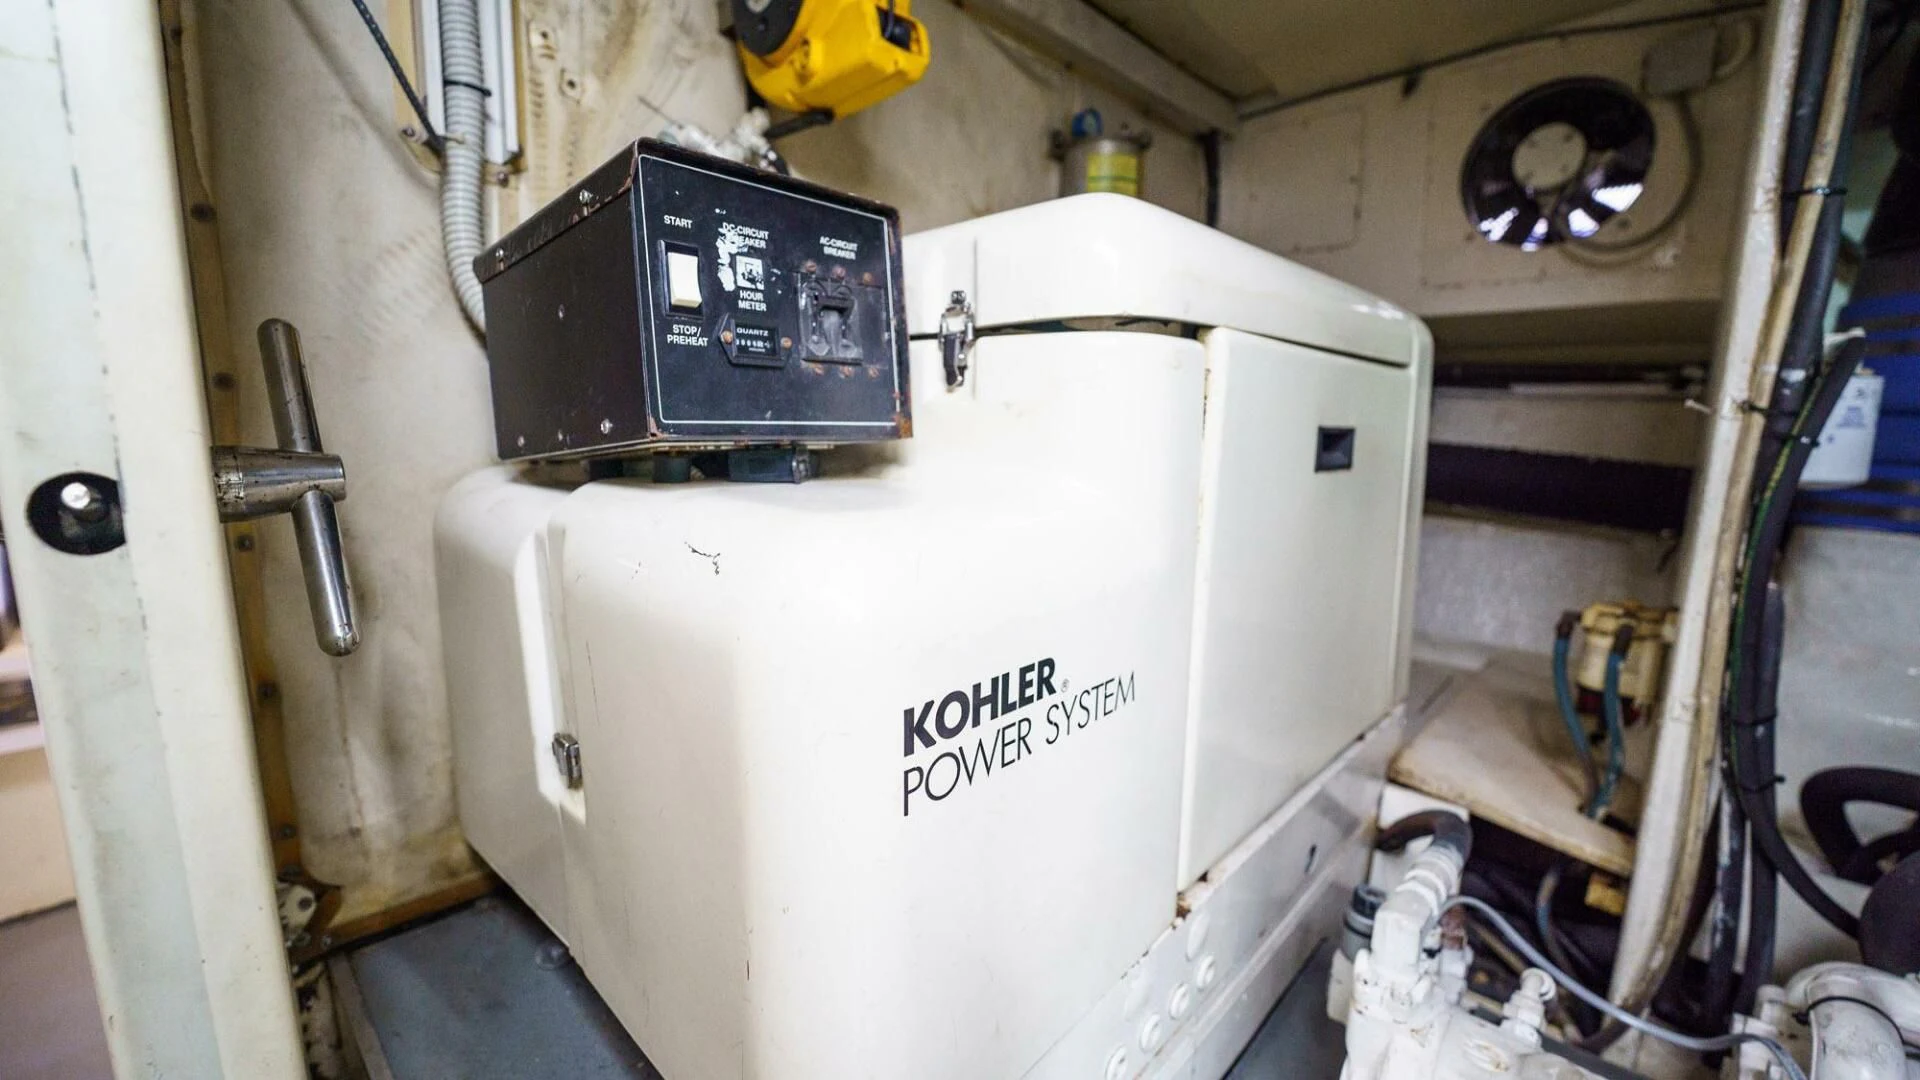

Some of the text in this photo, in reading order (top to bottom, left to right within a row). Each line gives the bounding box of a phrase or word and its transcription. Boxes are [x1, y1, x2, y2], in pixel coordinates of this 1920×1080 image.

[664, 216, 692, 229] START
[723, 222, 769, 239] DC-CIRCUIT
[740, 290, 764, 301] HOUR
[739, 300, 767, 311] METER
[672, 325, 701, 337] STOP/
[736, 328, 769, 336] QUARTZ
[667, 335, 709, 346] PREHEAT
[904, 658, 1056, 757] KOHLER
[904, 672, 1135, 816] POWER SYSTEM
